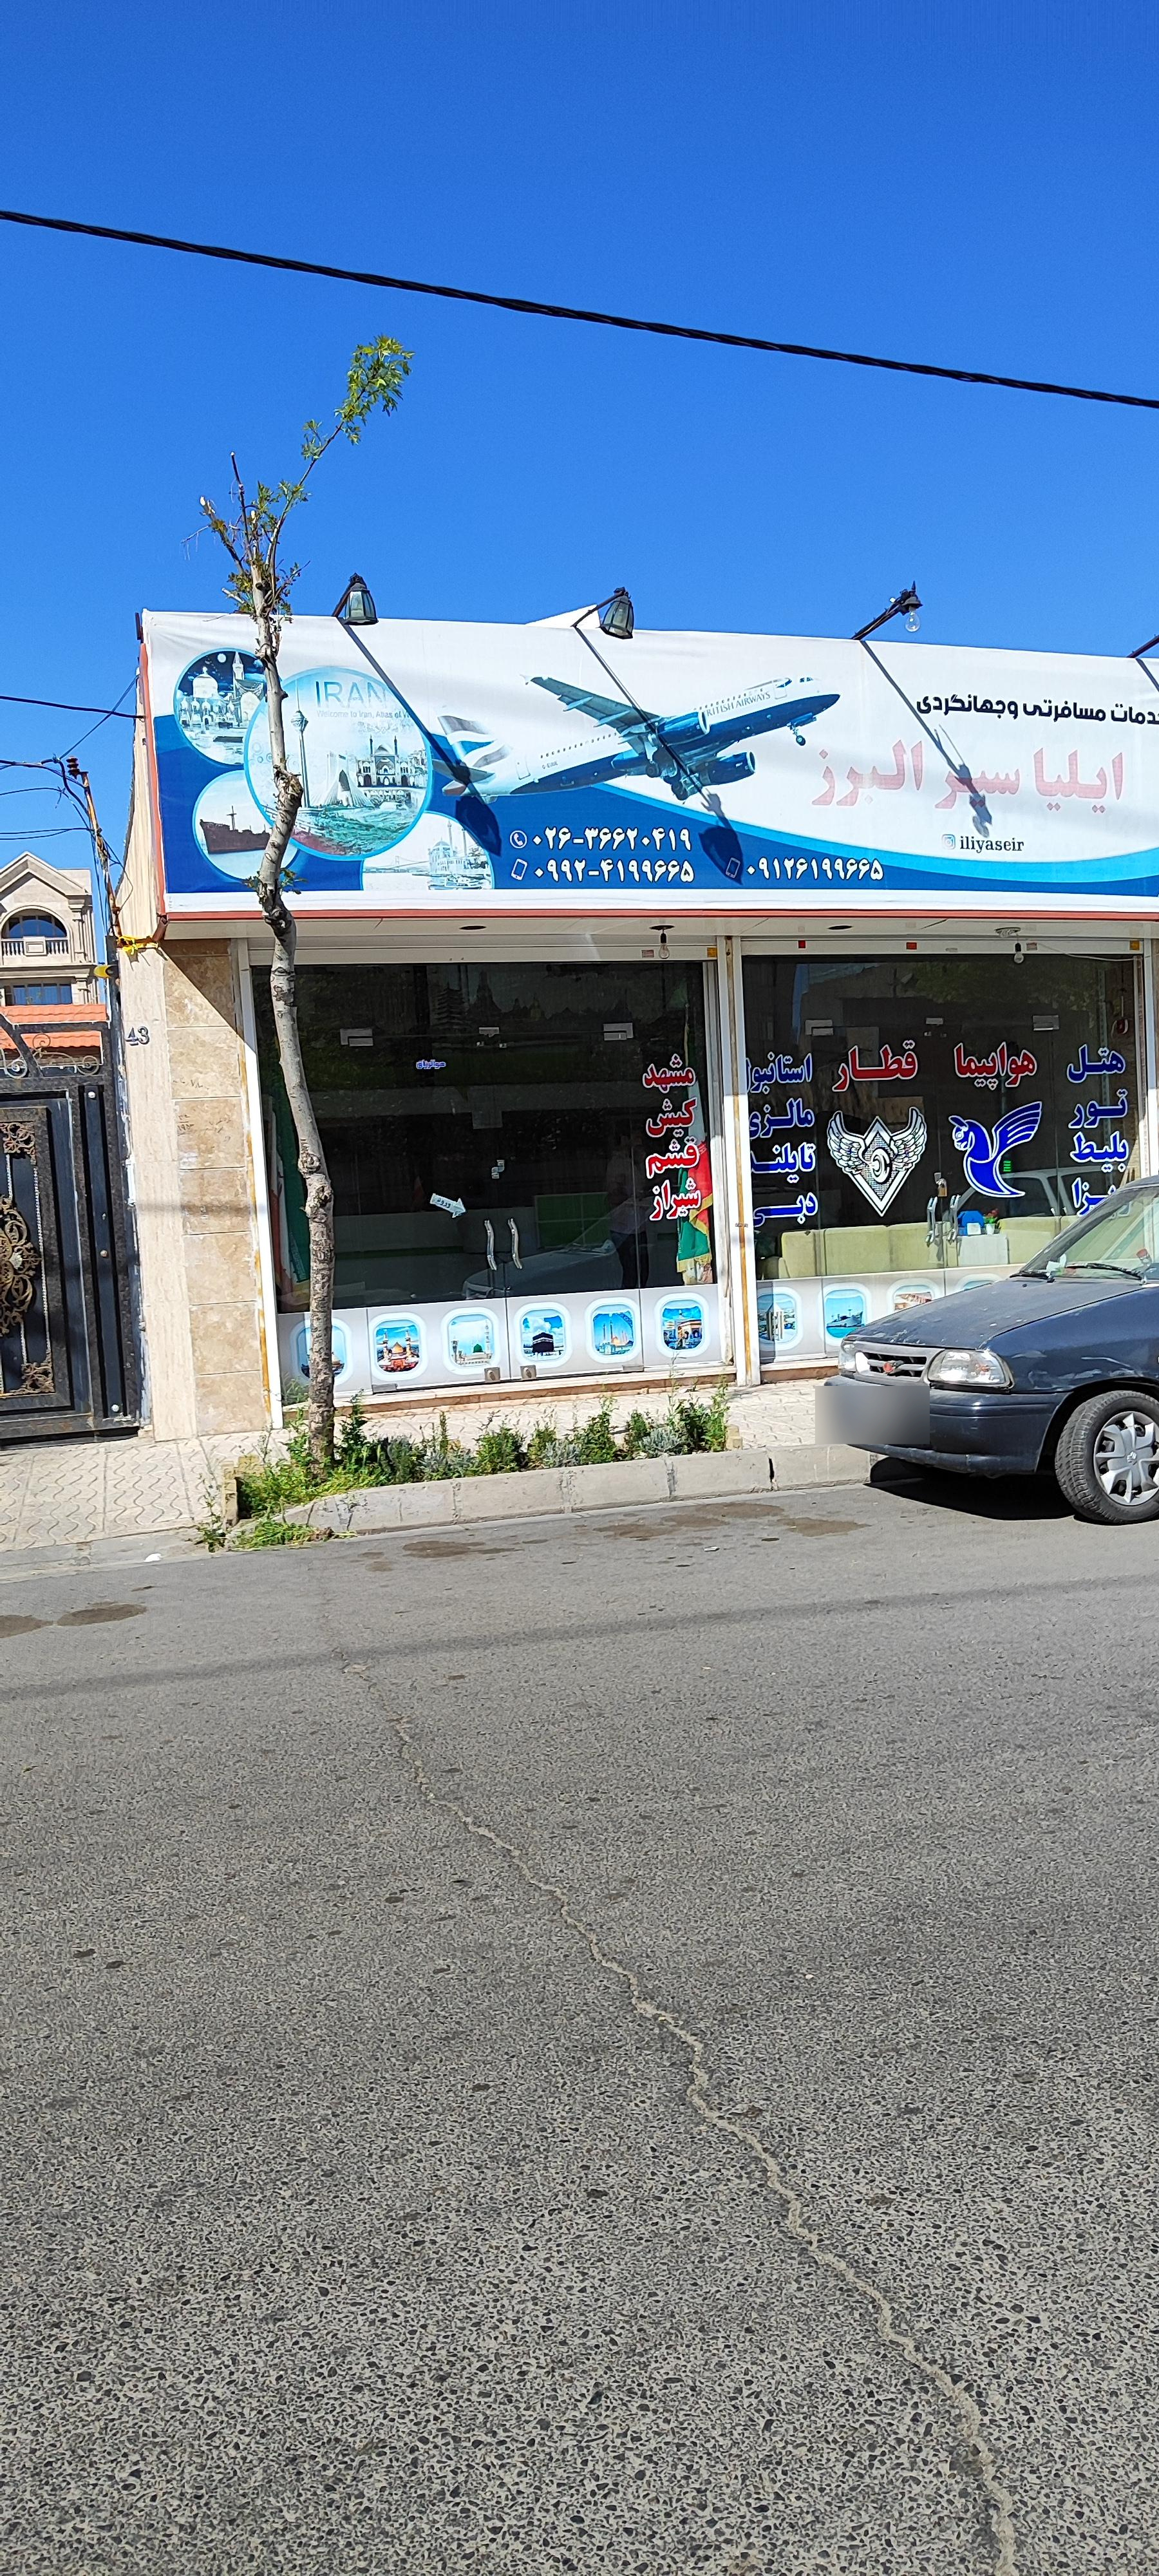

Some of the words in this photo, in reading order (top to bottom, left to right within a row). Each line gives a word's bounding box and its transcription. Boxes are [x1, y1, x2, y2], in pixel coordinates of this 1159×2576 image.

[316, 681, 387, 708] IRAN
[706, 701, 734, 716] RITISH
[735, 691, 771, 708] AIRWAYS
[1022, 699, 1106, 722] مسافرتی
[1111, 703, 1159, 725] دمات
[811, 739, 923, 807] البرز
[934, 766, 1021, 810] سیر
[1033, 746, 1124, 813] ایلیا
[532, 826, 692, 851] ۰۲۶-۳۶۶۲۰۴۱۹
[959, 836, 1024, 853] iliyaseir
[534, 858, 695, 883] ۰۹۹۲-۴۱۹۹۶۶۵
[747, 857, 884, 880] ۰۹۱۲۶۱۹۹۶۶۵
[125, 1027, 150, 1046] 43
[643, 1054, 696, 1093] مشهد
[832, 1040, 918, 1092] قطار
[954, 1041, 1037, 1090] هواپیما
[1066, 1044, 1126, 1083] هتل
[646, 1097, 697, 1137] کیش
[749, 1097, 815, 1140] مالزی
[1068, 1088, 1128, 1129] تور
[646, 1136, 700, 1179] قشم
[1069, 1131, 1129, 1173] بلیط
[650, 1177, 702, 1221] شیراز
[753, 1191, 818, 1227] دبی
